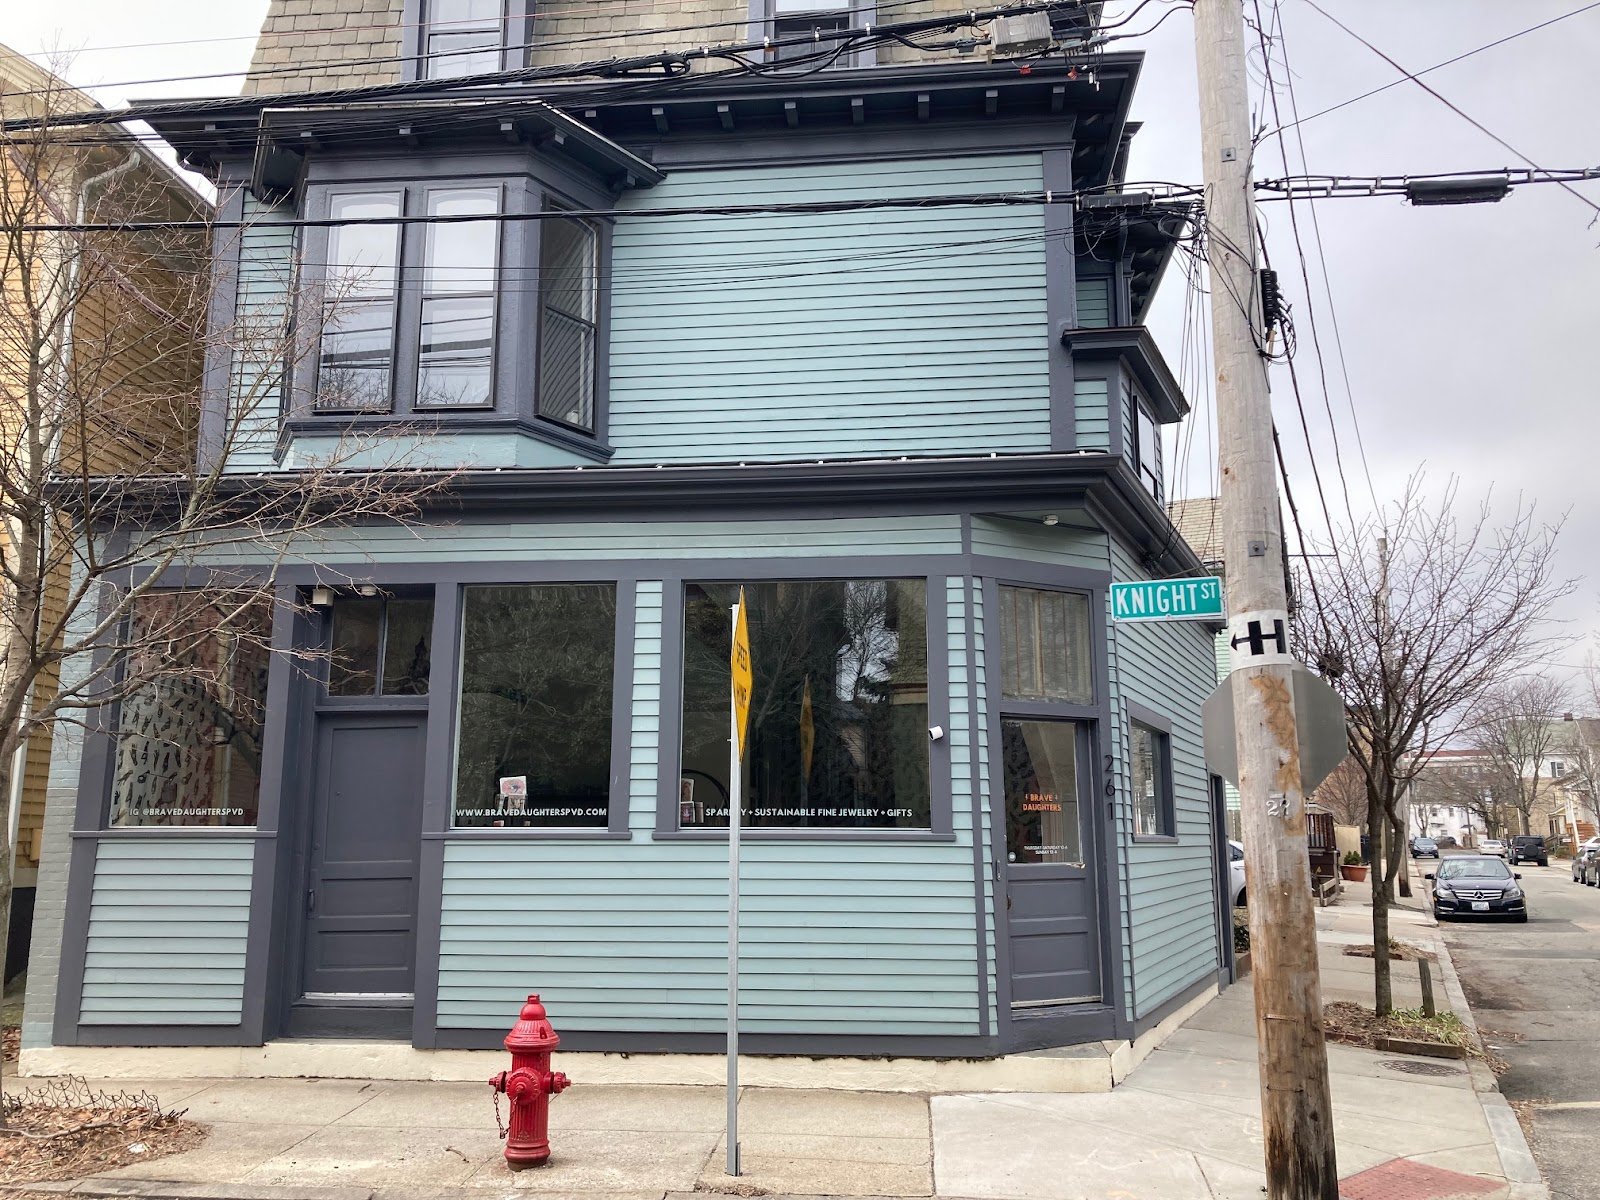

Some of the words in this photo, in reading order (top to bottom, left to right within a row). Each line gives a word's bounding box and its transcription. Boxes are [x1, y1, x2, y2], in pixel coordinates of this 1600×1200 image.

[1116, 584, 1197, 614] KNIGHT
[1201, 582, 1216, 599] ST
[1105, 754, 1116, 820] 261
[1030, 793, 1053, 802] BRAVE
[130, 808, 139, 816] IG
[142, 808, 244, 816] @BRAVEDAUGHTERSPVD
[456, 808, 607, 816] WWW.BRAVEDAUGHTERSPVD.COM
[705, 808, 747, 817] SPARY
[754, 808, 816, 817] SUSTAINABLE
[817, 808, 837, 817] FINE
[838, 808, 879, 817] JEWELRY
[886, 808, 913, 817] GIFTS
